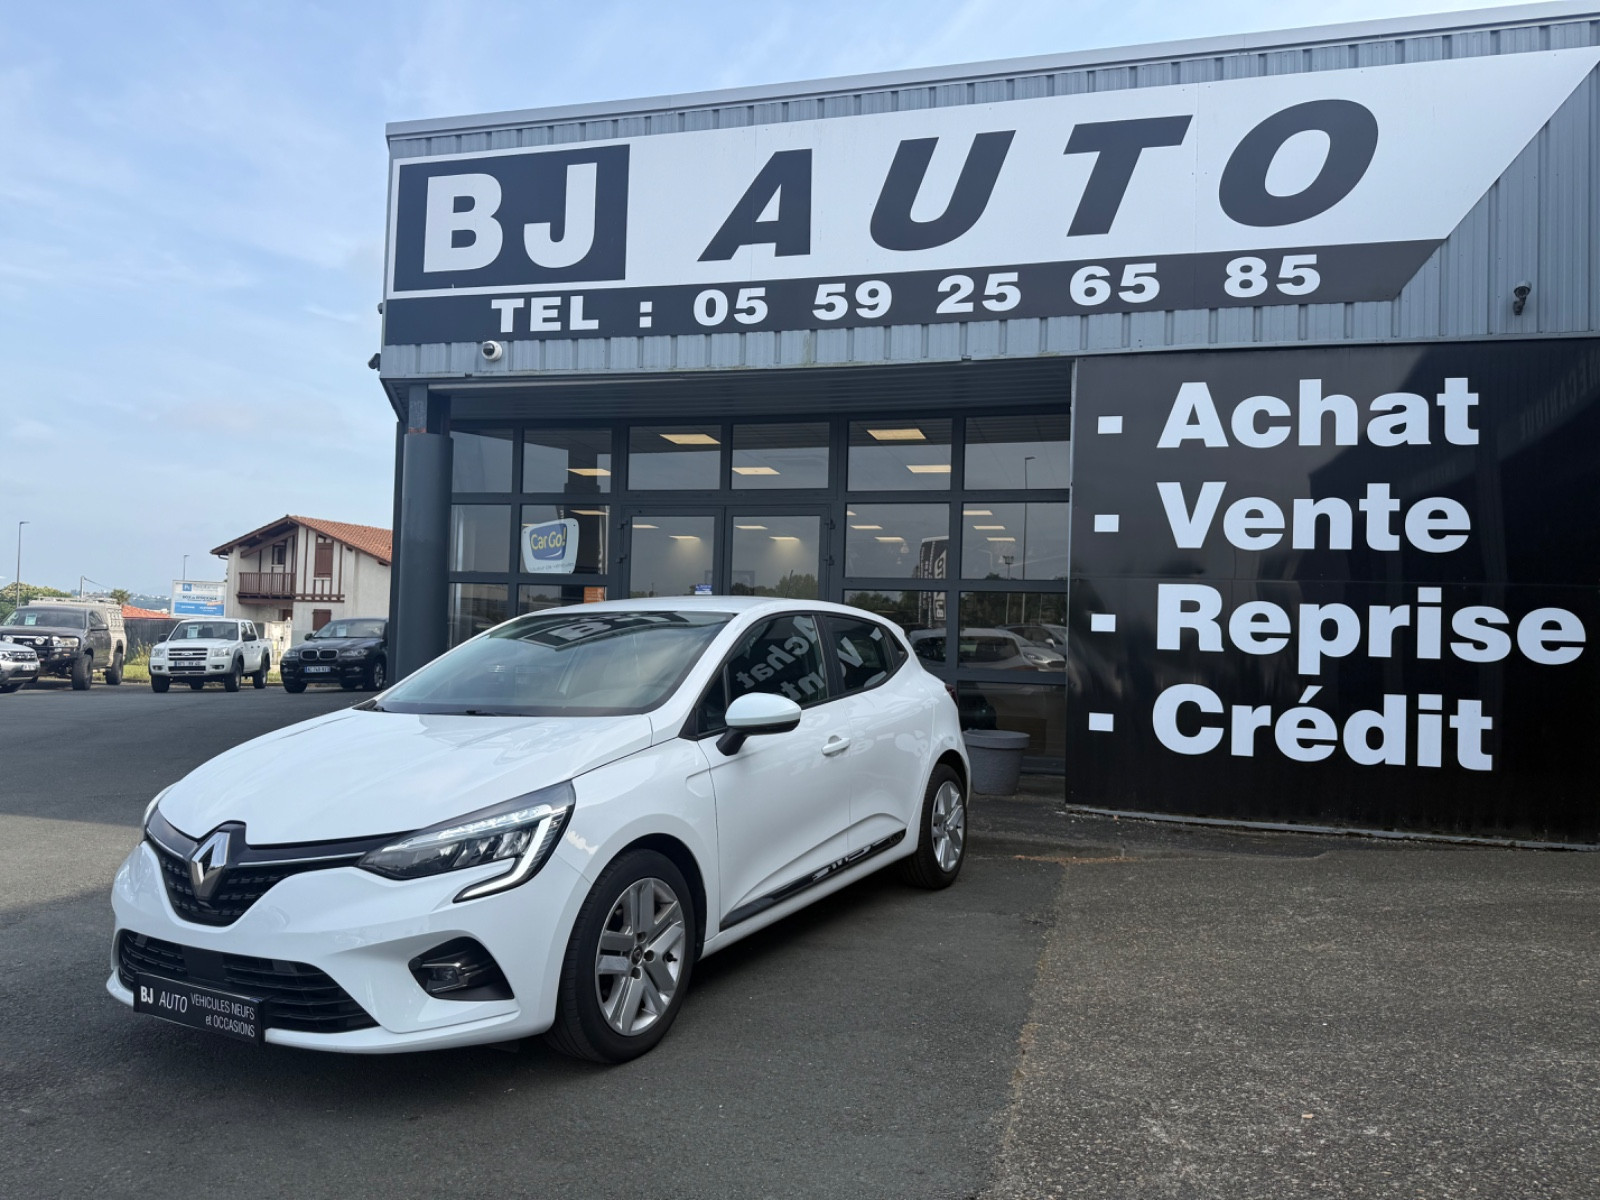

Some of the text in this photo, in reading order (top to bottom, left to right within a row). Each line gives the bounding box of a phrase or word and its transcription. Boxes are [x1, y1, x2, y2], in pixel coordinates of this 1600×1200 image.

[424, 99, 1378, 275] BJ AUTO
[491, 295, 599, 333] TEL
[693, 287, 768, 327] 05
[812, 280, 893, 322] 59
[935, 271, 1022, 315] 25
[1069, 262, 1160, 306] 65
[1224, 254, 1321, 298] 85
[1156, 377, 1480, 449] Achat
[1156, 482, 1471, 553] Vente
[1156, 584, 1586, 675] Reprise
[1152, 683, 1493, 771] Crédit
[140, 985, 255, 1020] BJ AUTO VEHICULES NEUFS
[205, 1014, 255, 1038] et OCCASIONS
